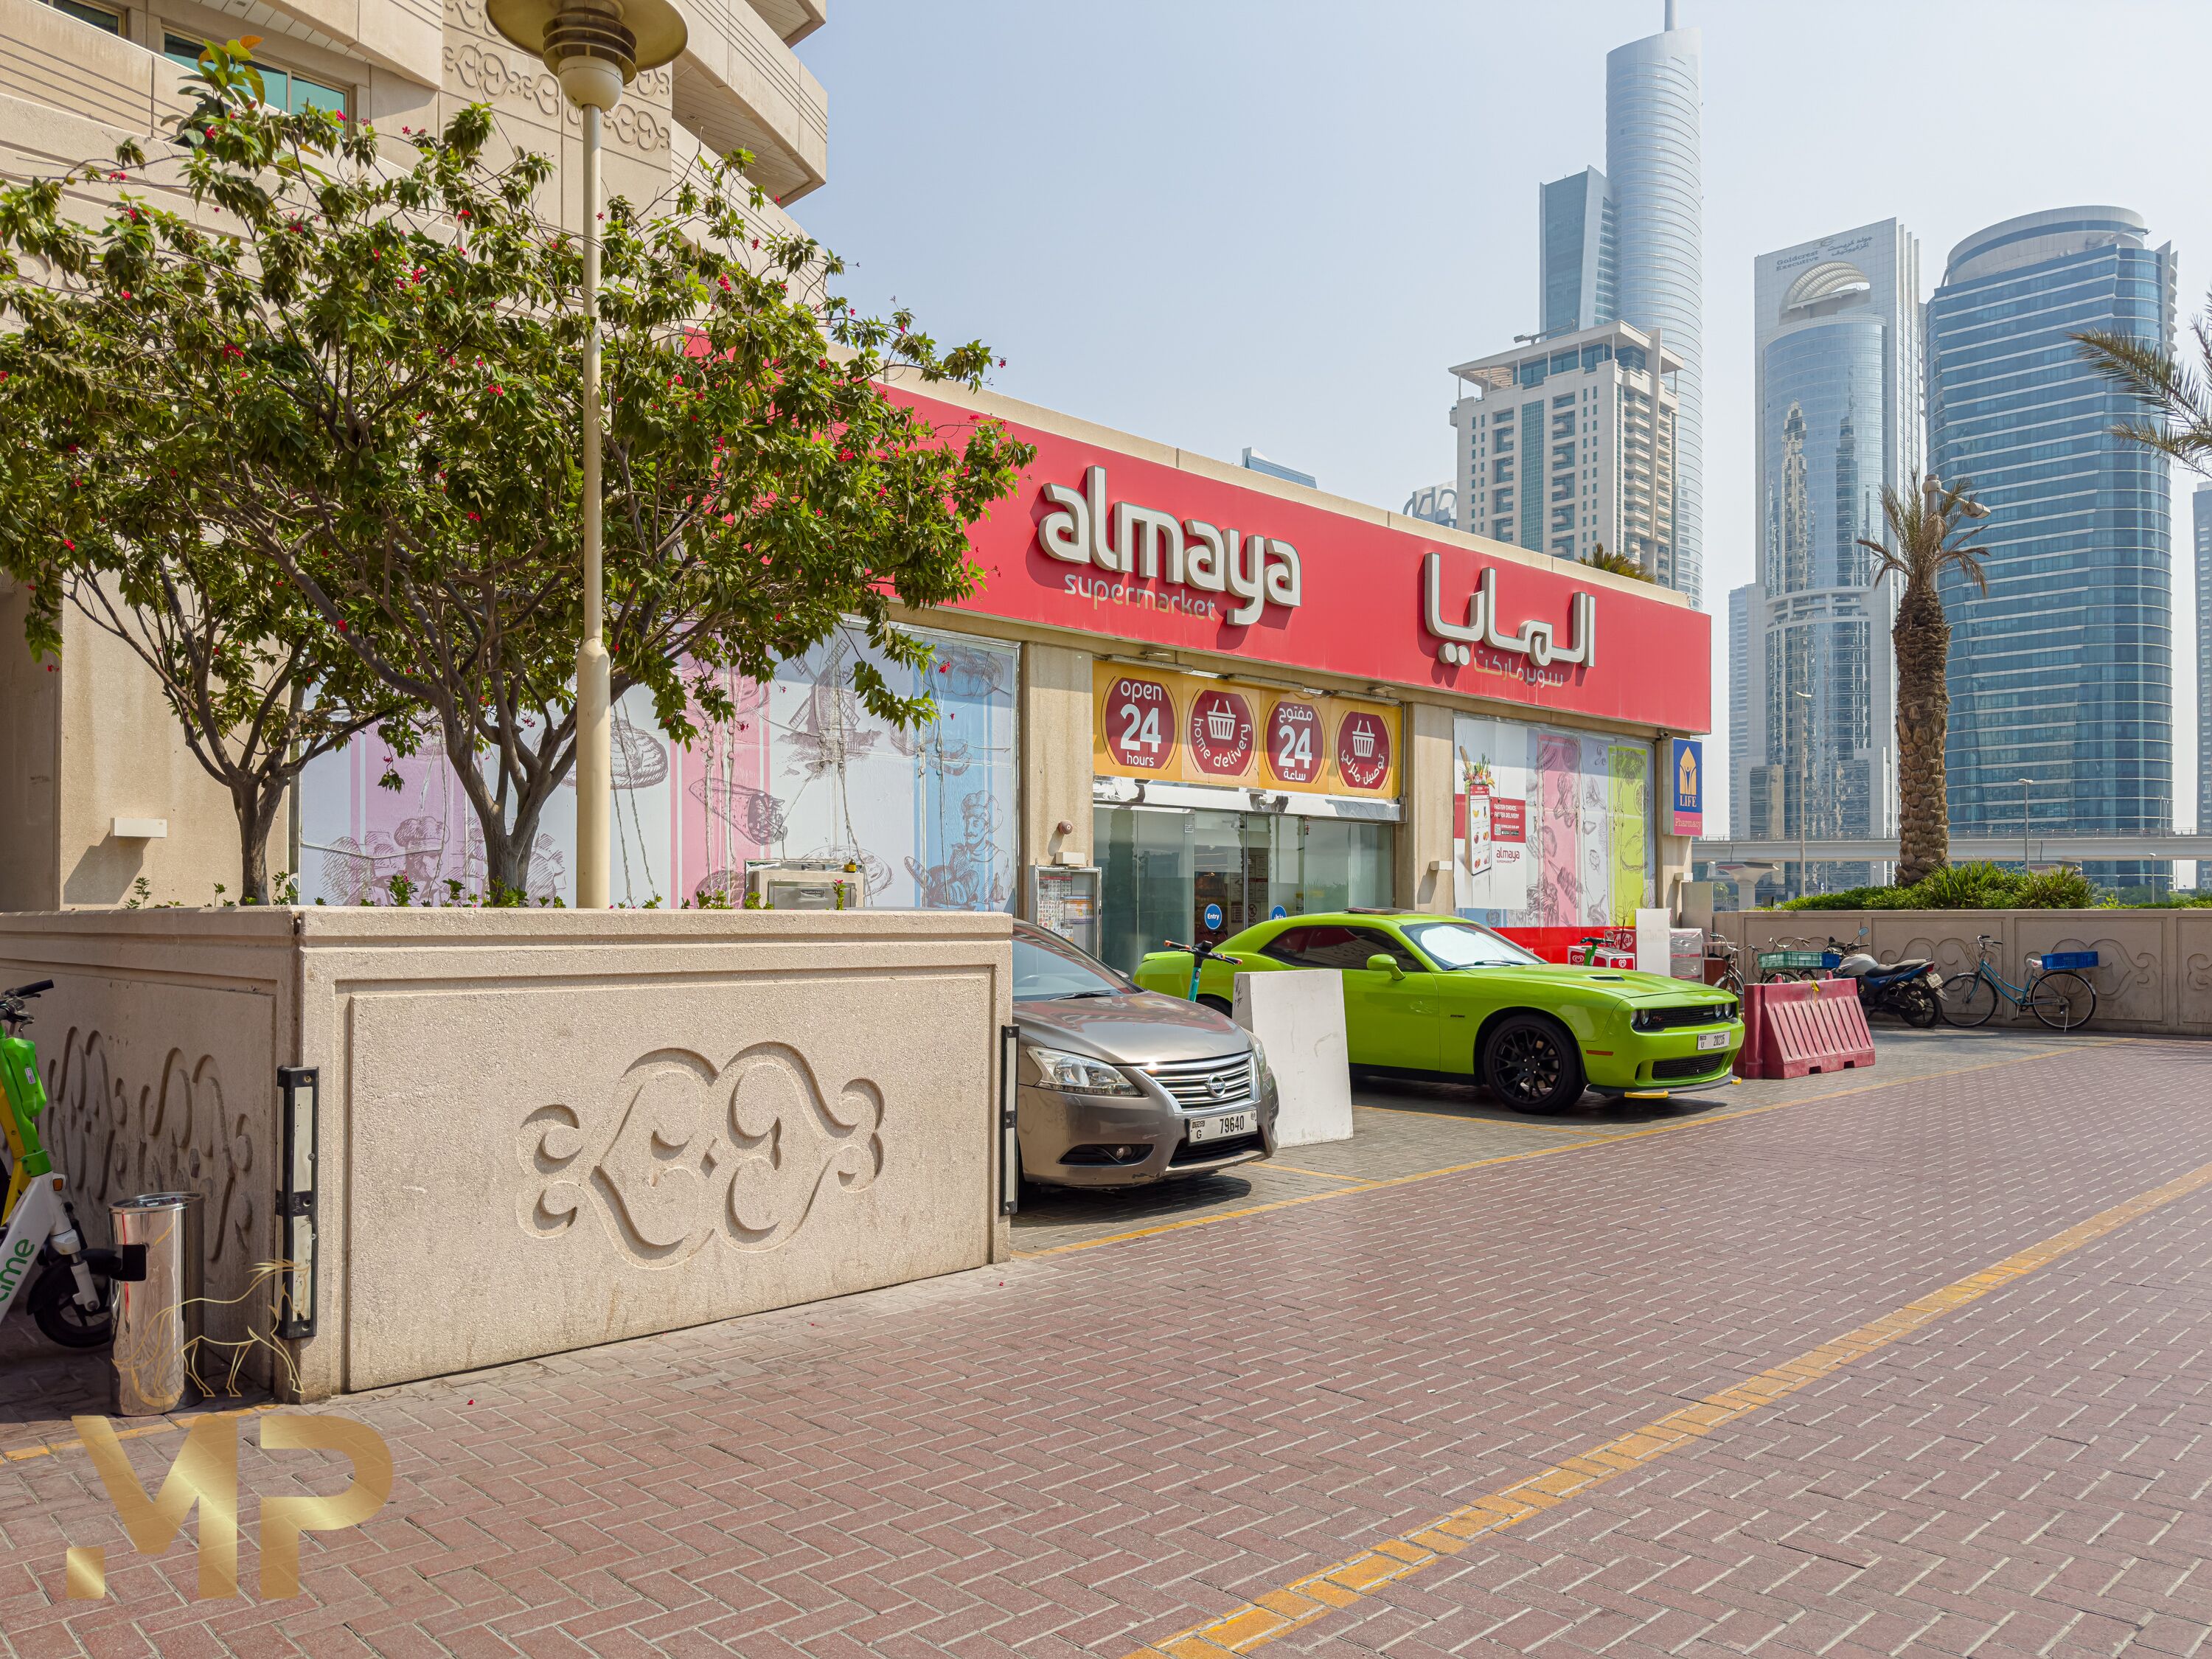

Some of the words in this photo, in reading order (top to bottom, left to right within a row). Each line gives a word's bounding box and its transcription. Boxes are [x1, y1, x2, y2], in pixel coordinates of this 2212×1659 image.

[1775, 257, 1819, 271] Executive
[1777, 251, 1818, 265] Goldcrest
[1038, 465, 1301, 626] almaya
[1064, 574, 1215, 622] supermarket
[1424, 552, 1596, 667] المايا
[1121, 681, 1162, 703] open
[1279, 706, 1313, 723] مفتوح
[1120, 703, 1162, 753] 24
[1194, 717, 1211, 759] home
[1213, 723, 1251, 768] delivery
[1278, 725, 1312, 769] 24
[1127, 751, 1155, 767] hours
[1283, 768, 1307, 781] ساعة
[1363, 753, 1385, 785] توصيل
[1680, 795, 1697, 807] LIFE
[1674, 818, 1702, 830] Pharmacy
[1496, 846, 1520, 862] almaya
[1207, 913, 1220, 921] Entry
[1220, 1115, 1245, 1134] 79640
[1196, 1130, 1202, 1139] G
[0, 1239, 35, 1302] ime
